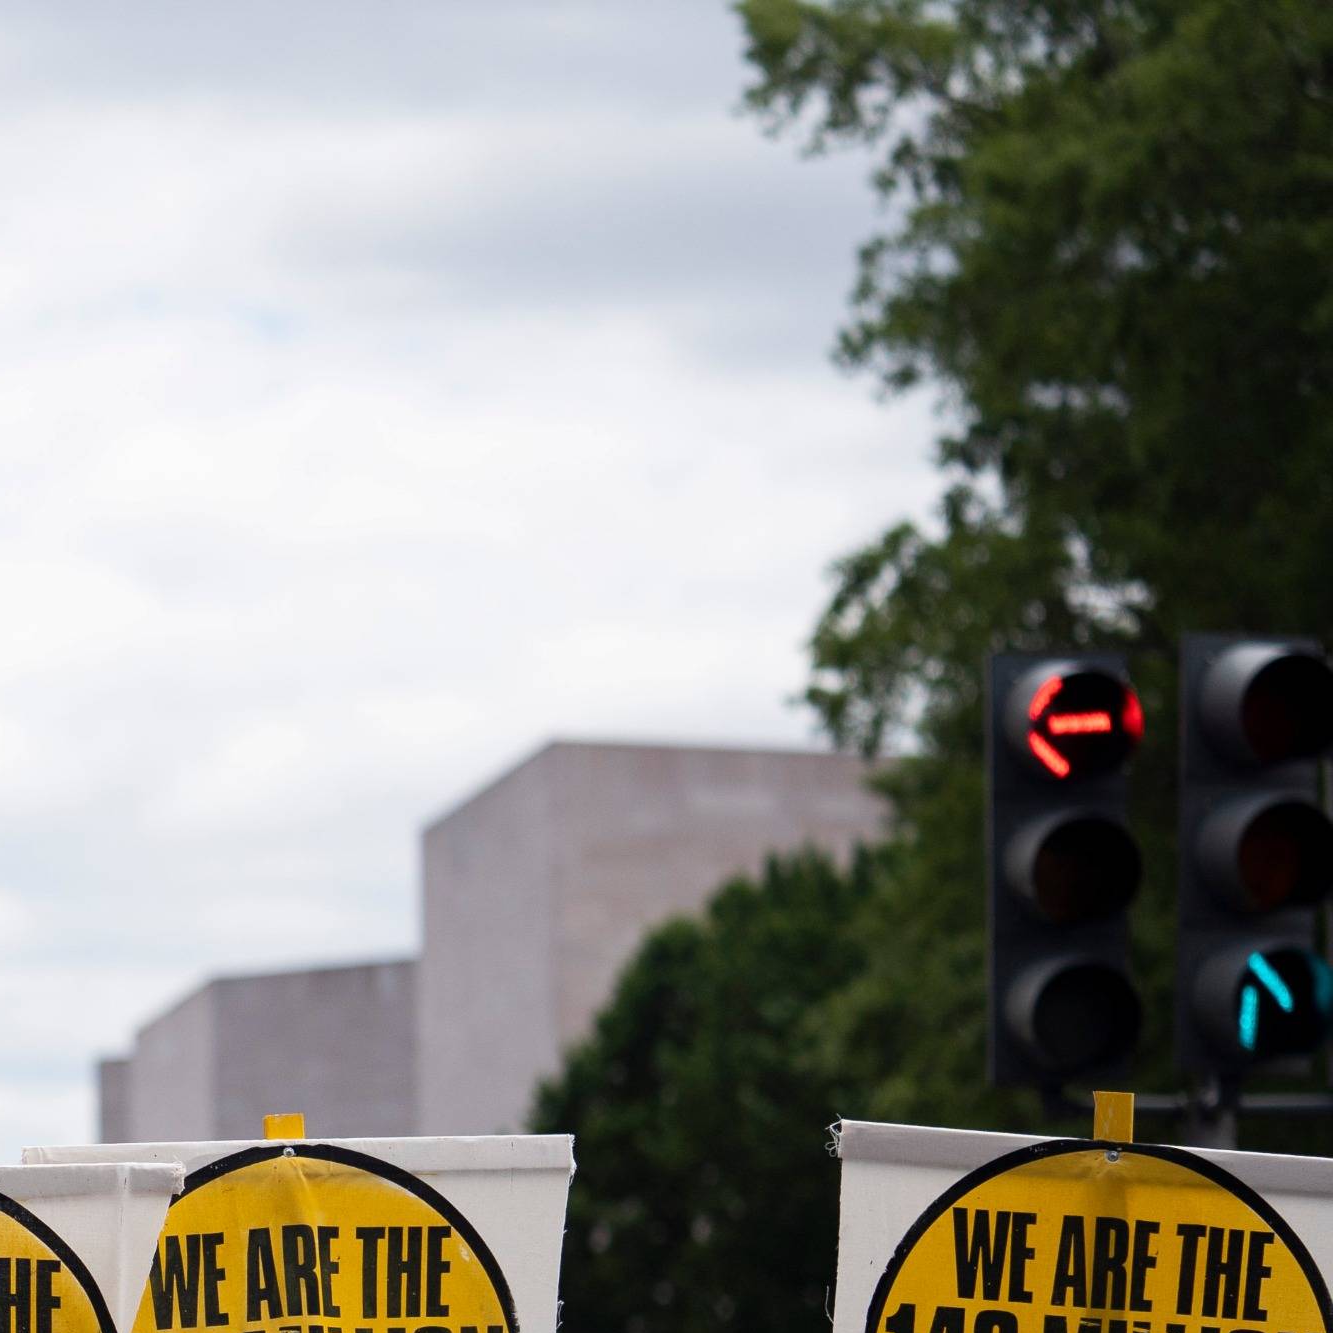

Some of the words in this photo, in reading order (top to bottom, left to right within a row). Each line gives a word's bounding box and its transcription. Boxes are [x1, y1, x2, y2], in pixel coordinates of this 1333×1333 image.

[151, 1232, 229, 1331] WE
[245, 1224, 341, 1322] ARE
[356, 1226, 452, 1318] THE
[953, 1207, 1037, 1303] WE
[1052, 1215, 1160, 1312] ARE
[1176, 1224, 1275, 1322] THE
